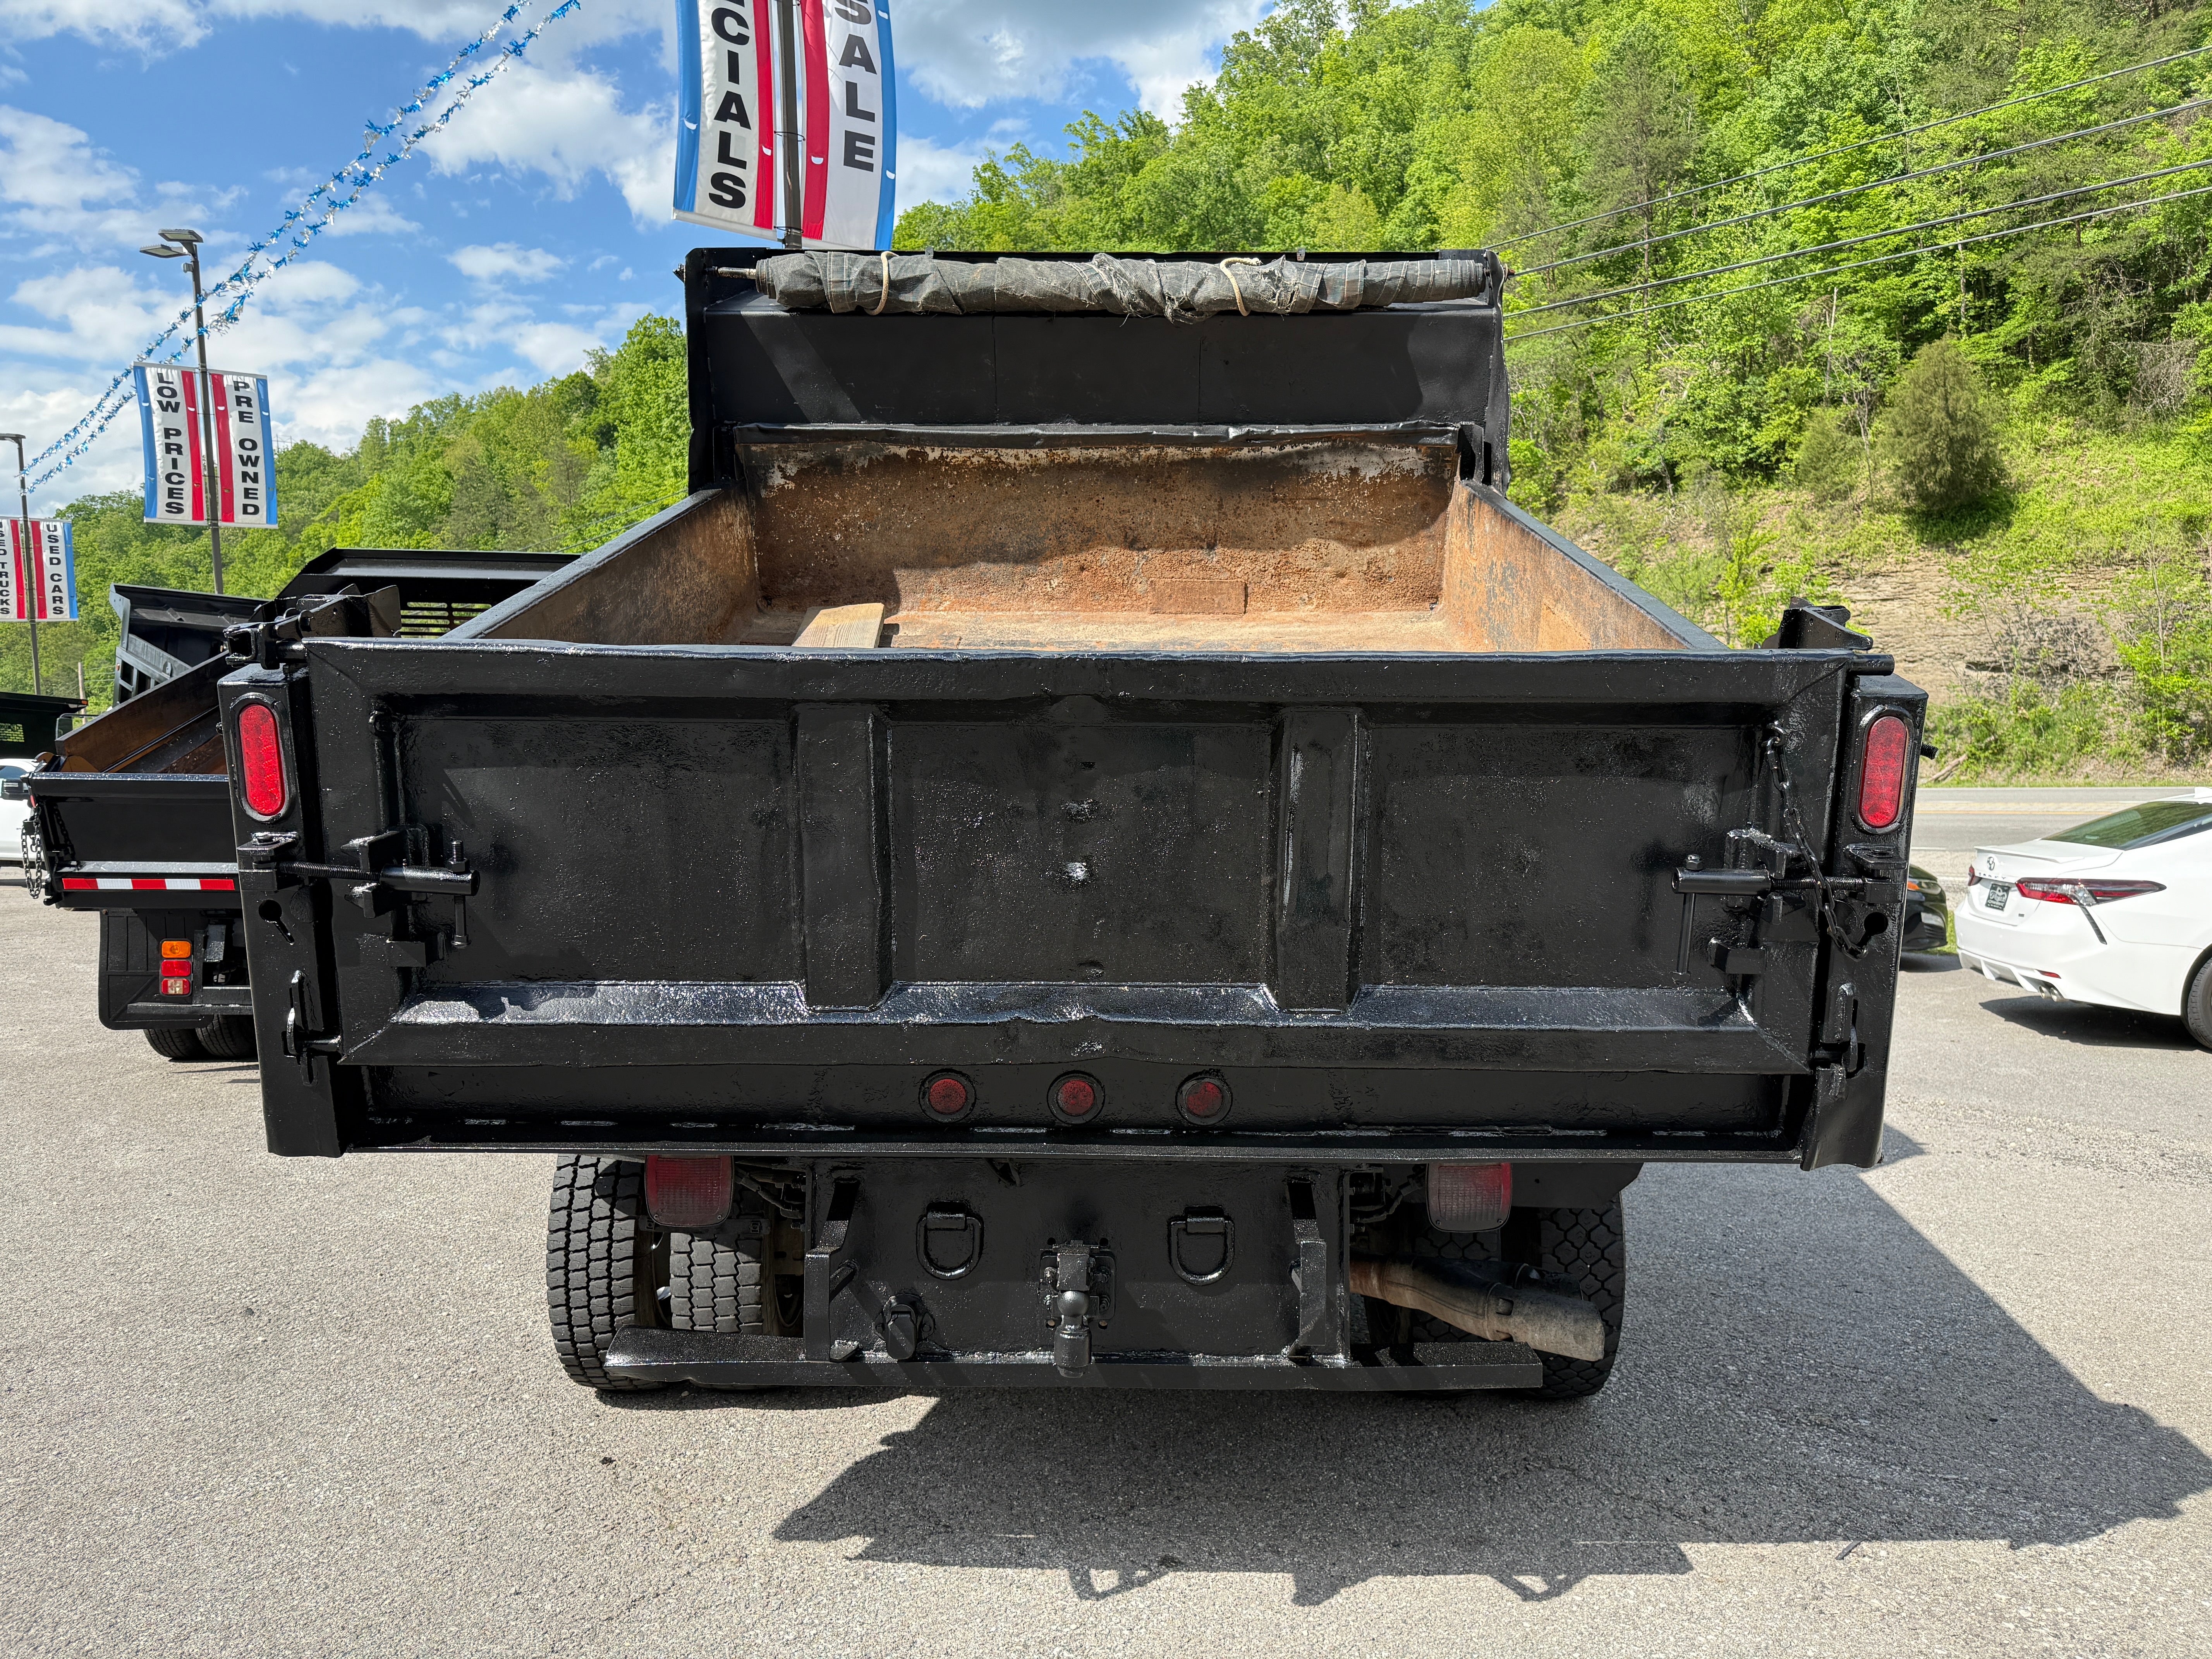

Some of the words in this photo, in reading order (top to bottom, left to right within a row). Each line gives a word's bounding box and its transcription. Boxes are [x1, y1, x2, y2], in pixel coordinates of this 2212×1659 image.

[709, 0, 751, 209] CIALS
[156, 373, 180, 413] LOW
[233, 380, 254, 424] PRE
[163, 427, 185, 515] PRICES
[238, 438, 260, 515] OWNED
[46, 524, 61, 566] USED
[0, 562, 10, 614] TRUCKS
[50, 573, 64, 615] CARS
